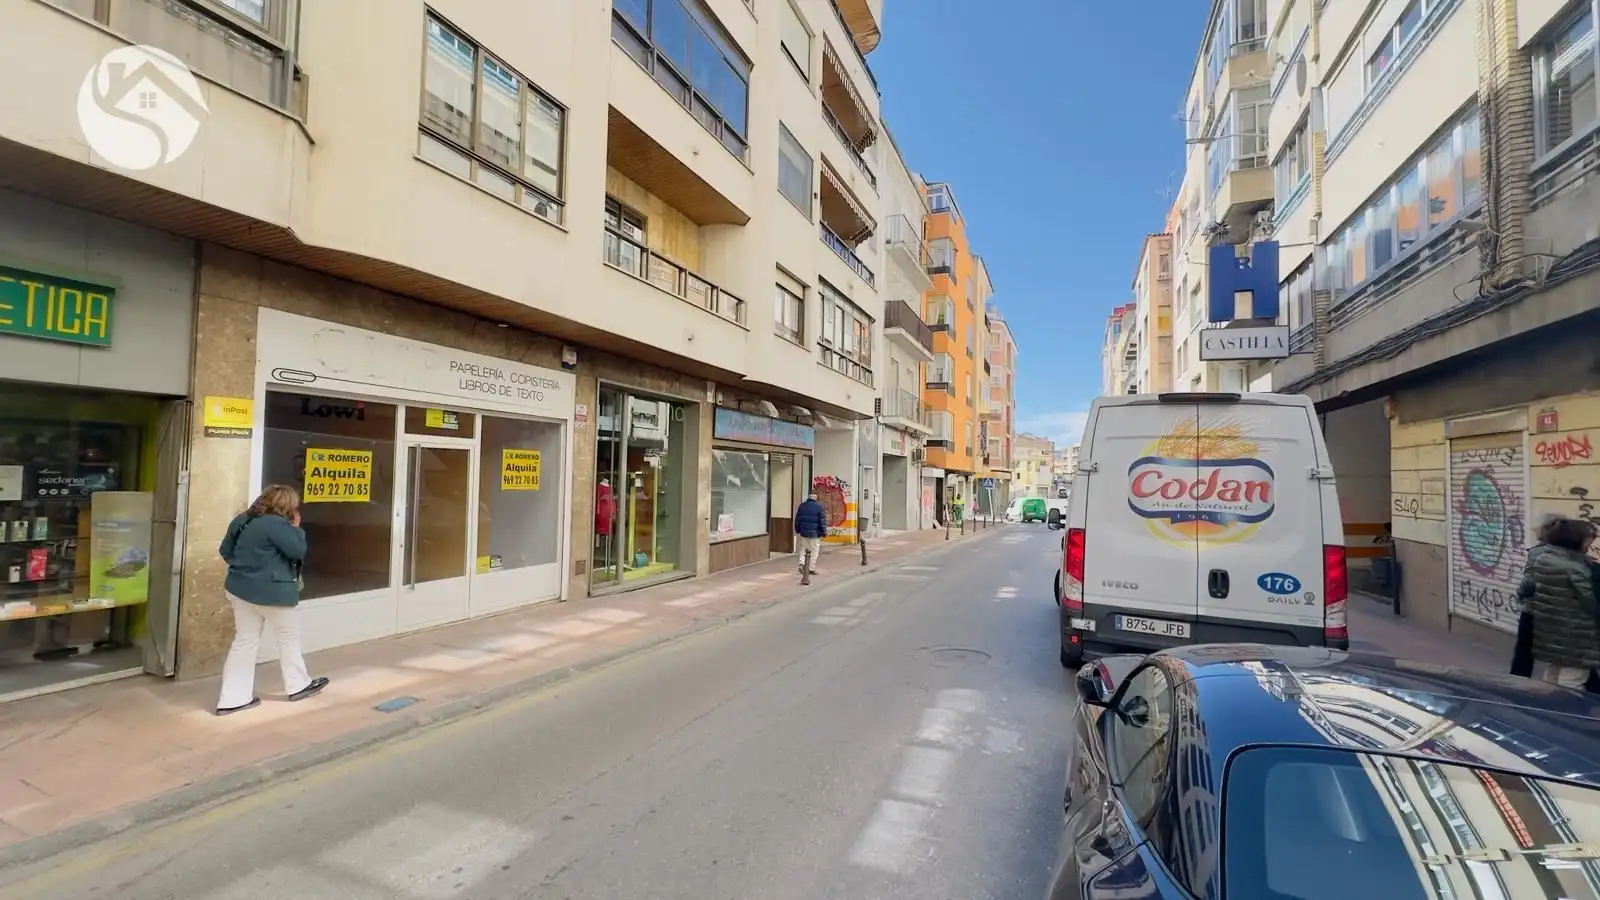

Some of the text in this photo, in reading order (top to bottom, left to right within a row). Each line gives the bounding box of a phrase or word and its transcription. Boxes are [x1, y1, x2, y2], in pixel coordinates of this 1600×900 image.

[1205, 336, 1284, 350] CASTILLA
[459, 379, 544, 402] LIBROS DE TEXTO
[300, 398, 365, 421] Lowi
[327, 454, 370, 464] ROMERO
[514, 453, 540, 461] ROMERO
[310, 467, 366, 480] Alquila
[505, 463, 538, 473] Alquila
[503, 475, 539, 485] 969 22 70 85
[1131, 468, 1271, 504] Codan
[307, 483, 369, 496] 969 22 70 85
[1102, 580, 1139, 591] IVECO
[1264, 577, 1294, 592] 176
[1126, 619, 1185, 637] 8754 JFB
